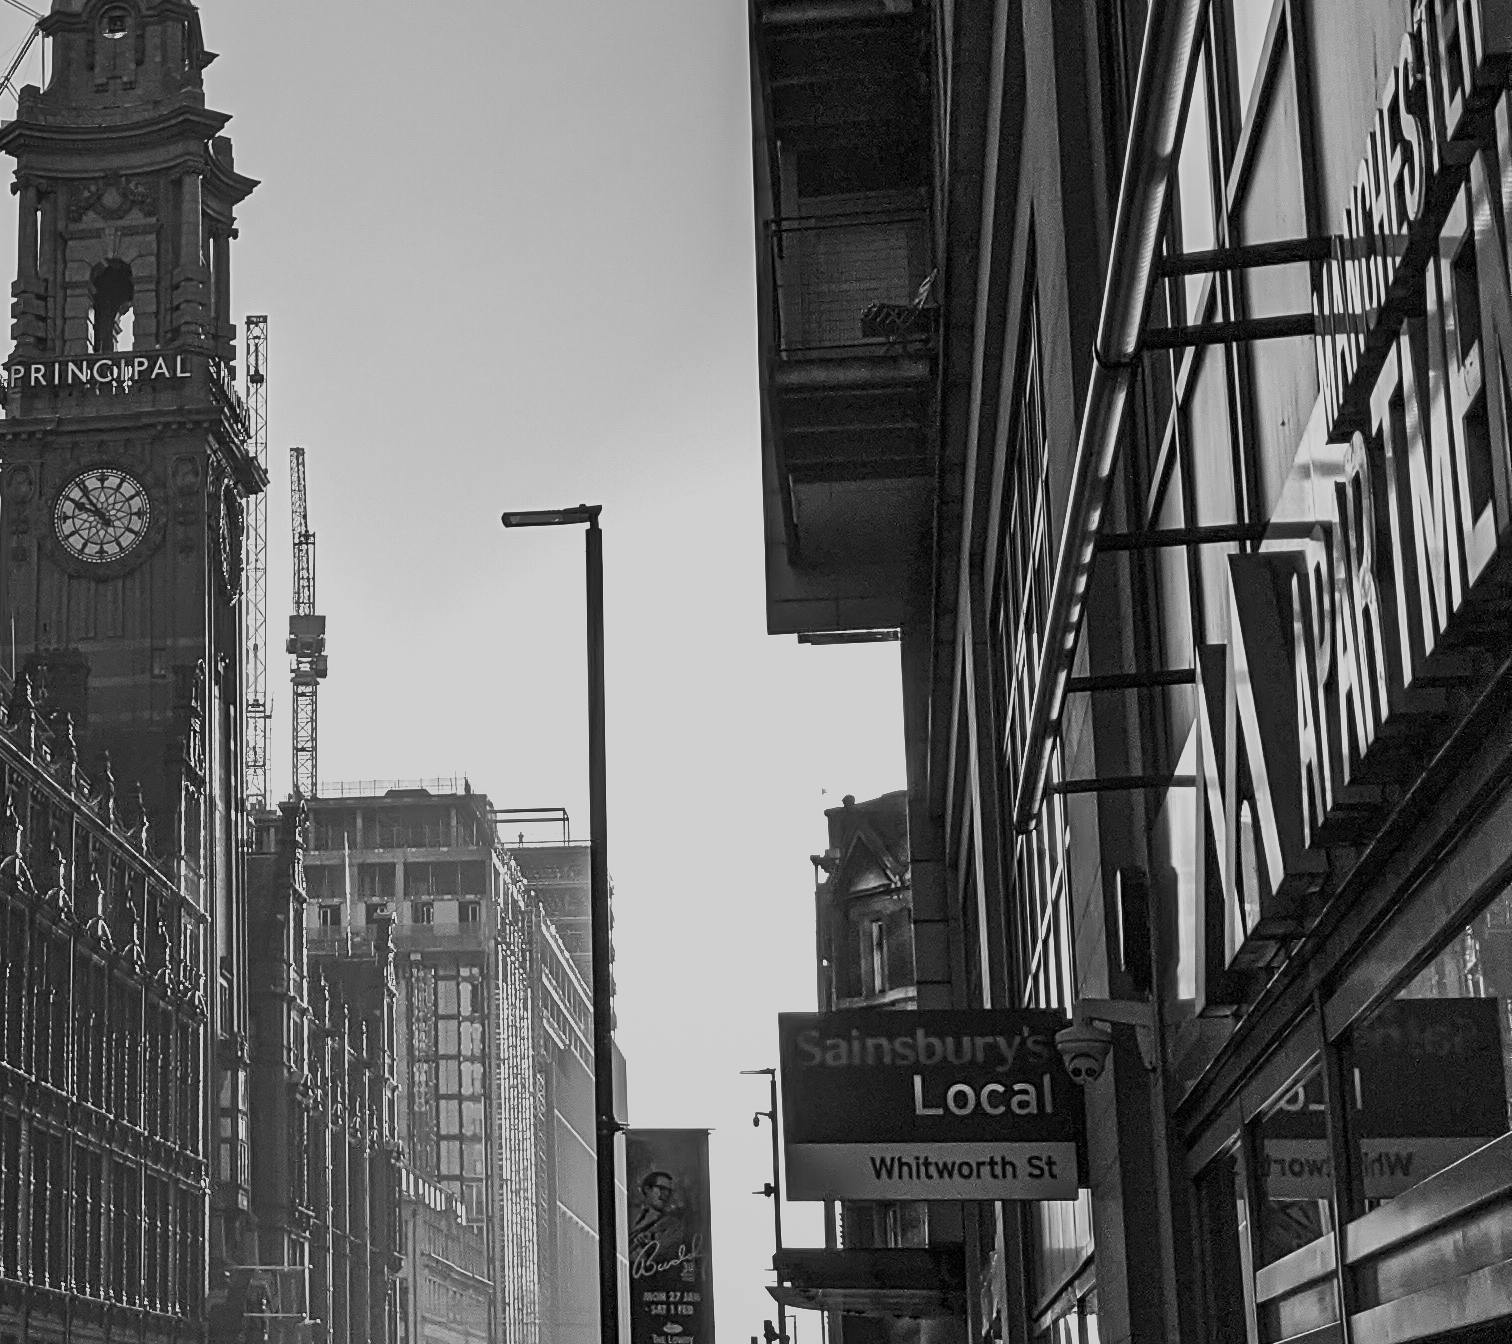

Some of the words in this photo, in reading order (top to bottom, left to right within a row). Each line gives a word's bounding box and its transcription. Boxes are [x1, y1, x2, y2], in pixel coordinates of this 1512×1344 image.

[10, 355, 192, 387] PRINCIPAL
[796, 1026, 1049, 1072] Sainsbury's
[912, 1073, 1054, 1116] Local
[870, 1156, 1018, 1181] Whitworth
[1027, 1156, 1059, 1180] St
[669, 1291, 681, 1302] 27
